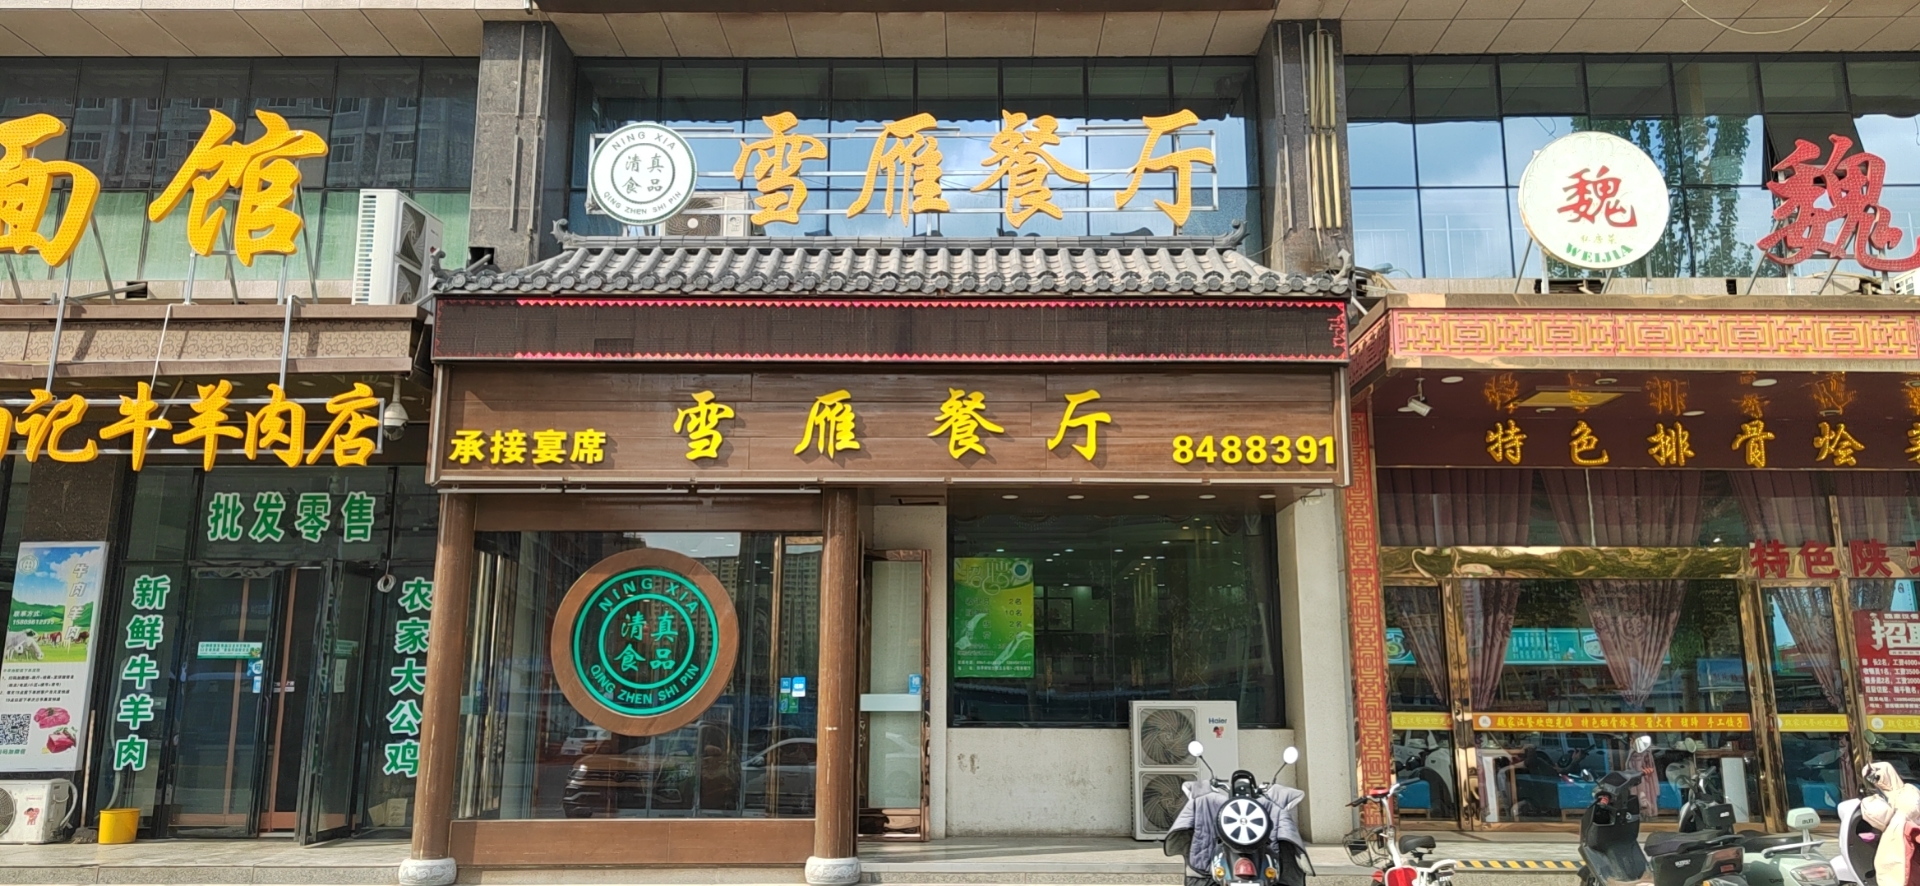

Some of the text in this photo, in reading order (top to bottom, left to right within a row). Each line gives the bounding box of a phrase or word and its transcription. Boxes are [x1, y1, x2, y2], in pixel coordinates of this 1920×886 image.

[611, 131, 676, 151] NING XIA
[625, 152, 665, 173] 清真
[733, 110, 1215, 228] 雪雁餐厅
[603, 190, 682, 215] QING ZHEN SHI PIN
[622, 176, 663, 194] 食品
[1556, 165, 1638, 228] 魏
[1757, 133, 1920, 272] 魏
[1566, 242, 1634, 263] WEIJIA
[0, 379, 381, 471] 记牛羊肉店
[673, 389, 1111, 461] 雪雁餐厅
[449, 428, 607, 464] 承接宴席
[1172, 435, 1336, 465] 8488391
[207, 492, 376, 541] 批发零售
[65, 562, 89, 641] 牛肉羊肉
[598, 577, 699, 614] NING XIA
[621, 610, 679, 642] 清真
[113, 574, 171, 771] 新鲜牛羊肉
[613, 643, 676, 672] 食品
[383, 577, 434, 778] 农家大公鸡
[590, 664, 700, 704] QING ZHEN SHI PIN
[1208, 717, 1228, 725] Haier
